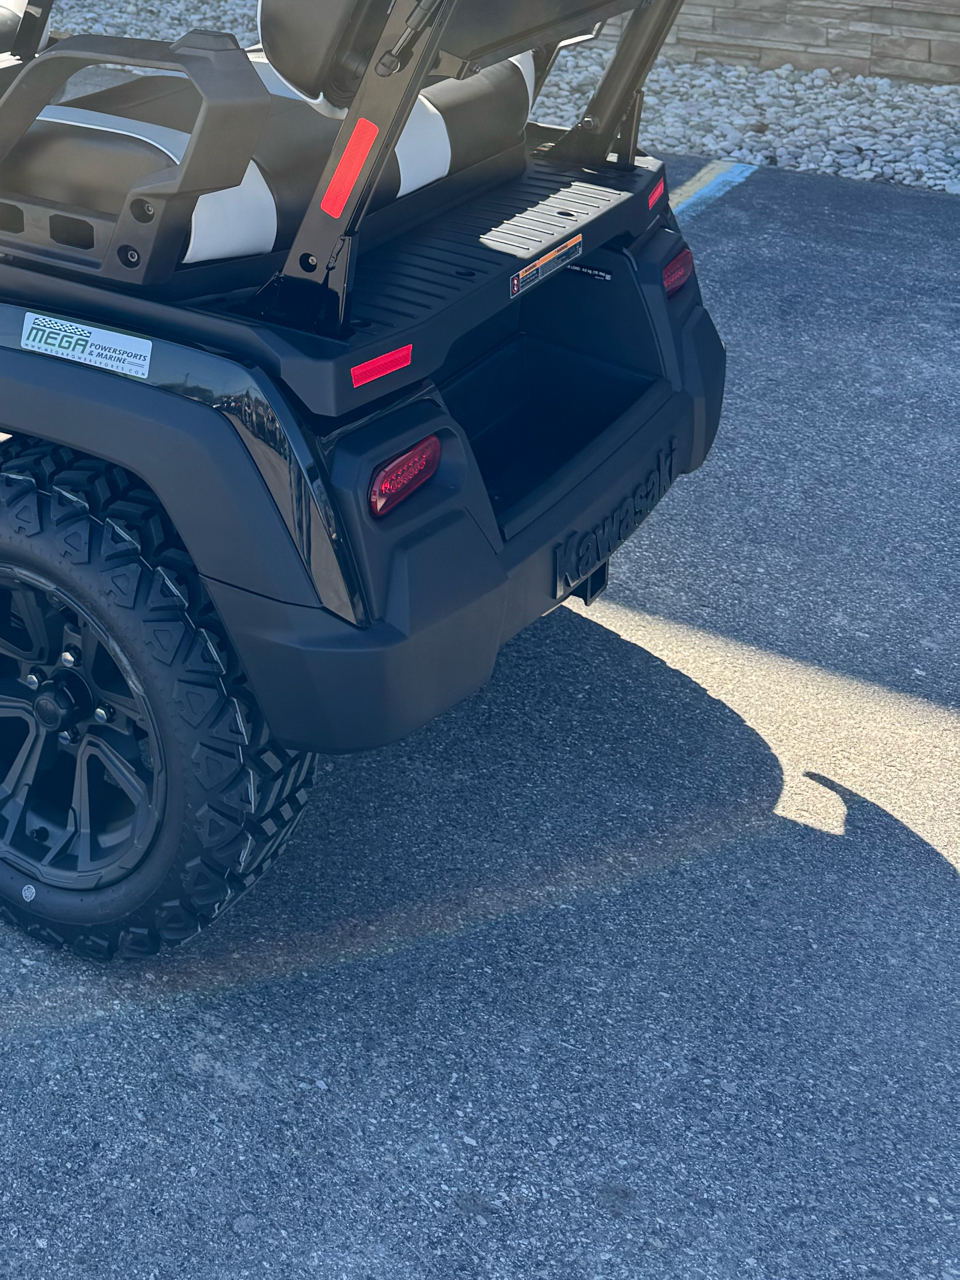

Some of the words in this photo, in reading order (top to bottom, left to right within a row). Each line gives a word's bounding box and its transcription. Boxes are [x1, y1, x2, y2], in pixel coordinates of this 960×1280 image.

[26, 326, 90, 354] MEGA
[89, 342, 148, 362] POWERSPORTS
[95, 352, 127, 365] MARINE
[553, 435, 677, 600] Kawasaki
